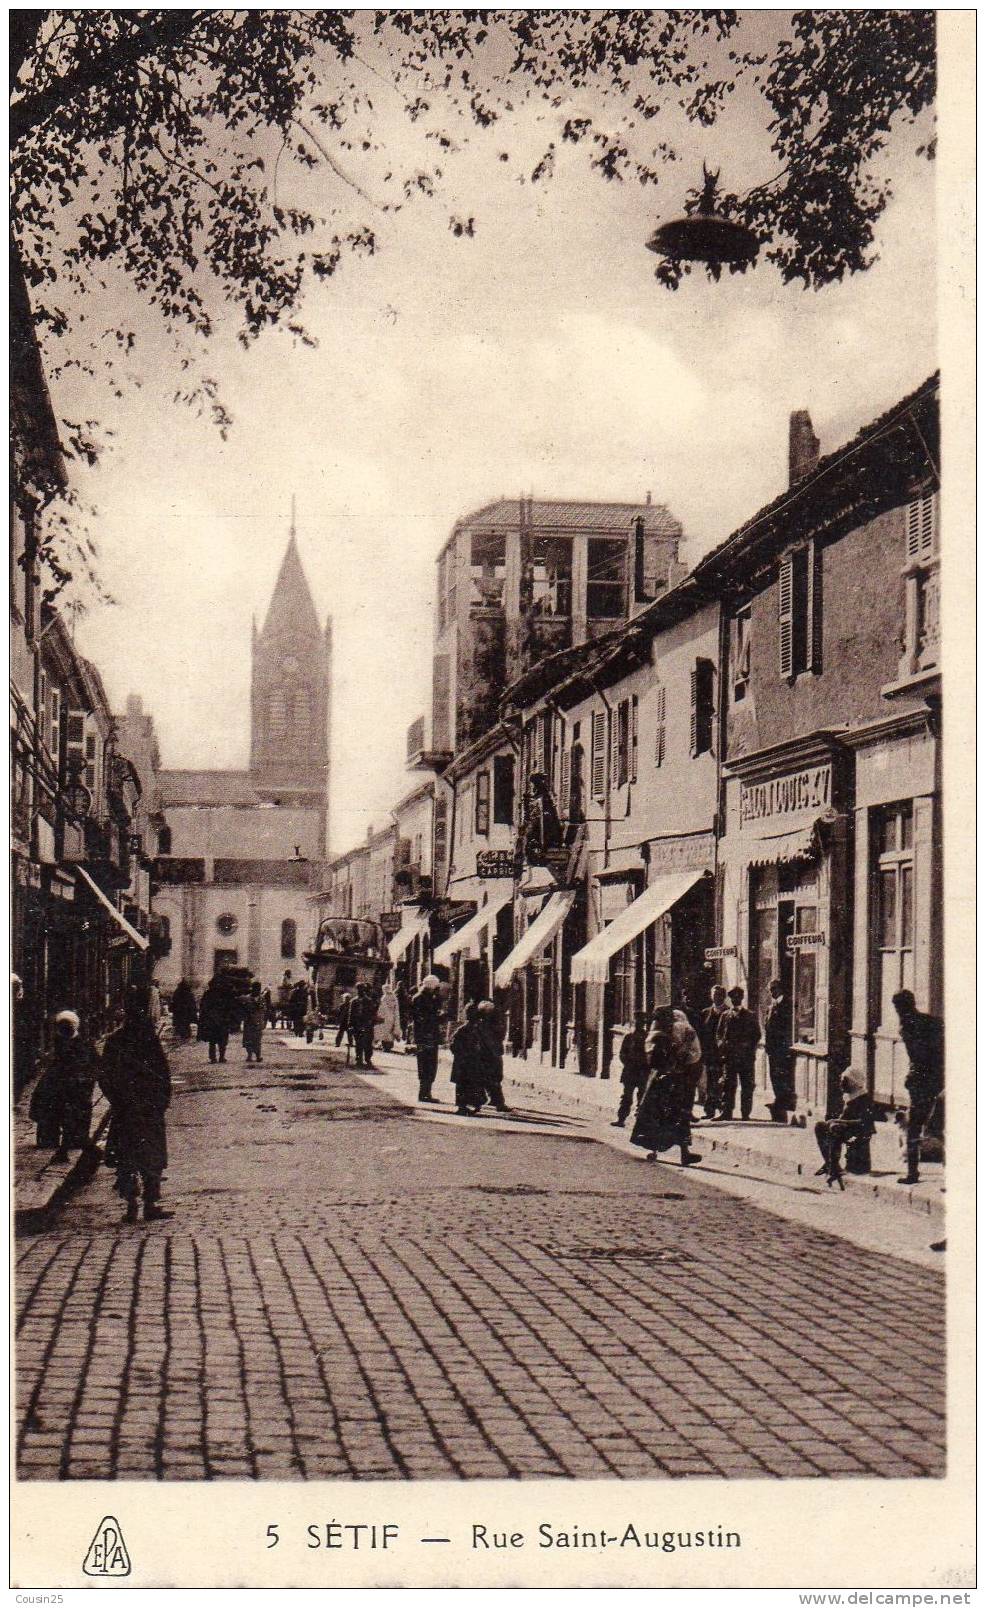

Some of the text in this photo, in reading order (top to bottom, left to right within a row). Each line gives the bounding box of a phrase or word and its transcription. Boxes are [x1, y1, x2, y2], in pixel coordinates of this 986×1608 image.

[776, 773, 809, 813] LOUIS
[787, 933, 822, 947] COIFFEUR
[706, 947, 734, 959] COIFFEUR
